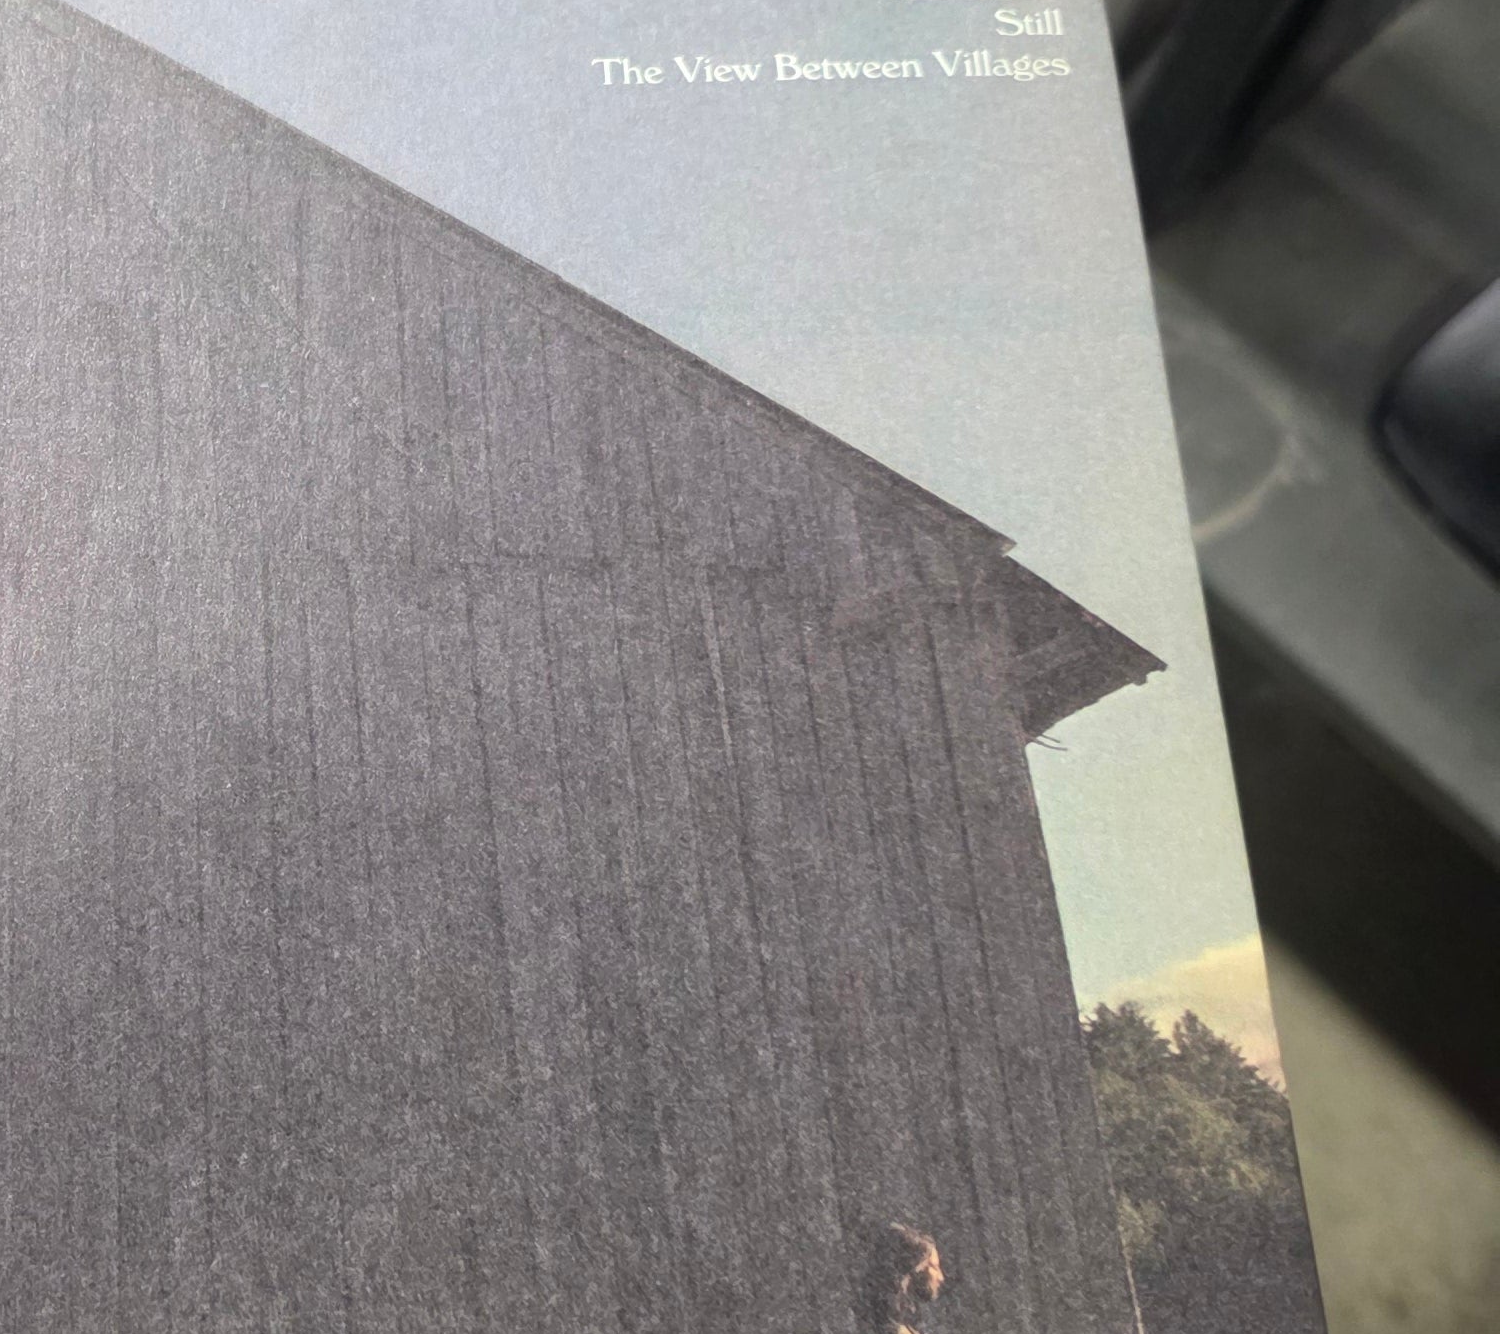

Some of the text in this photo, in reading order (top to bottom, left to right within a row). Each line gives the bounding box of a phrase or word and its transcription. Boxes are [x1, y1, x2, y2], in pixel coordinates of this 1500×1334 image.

[994, 8, 1063, 37] Still
[591, 49, 1071, 86] The View Between Villages
